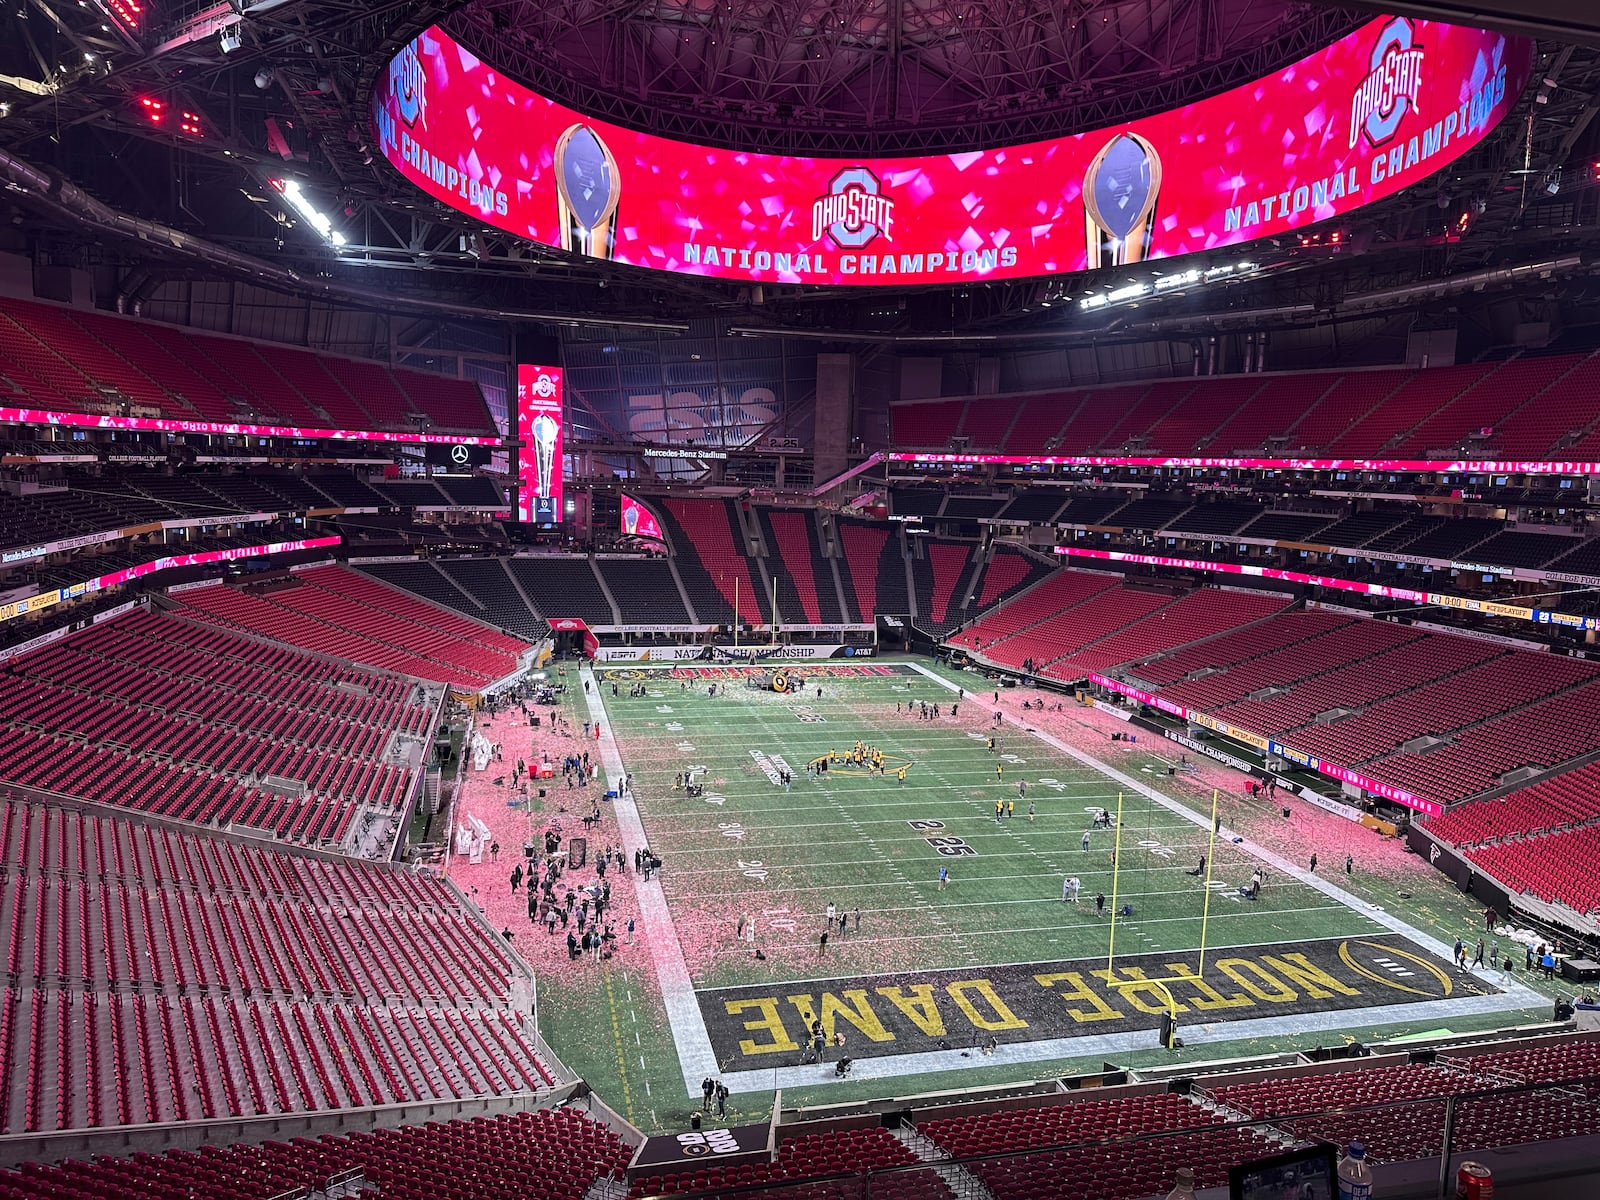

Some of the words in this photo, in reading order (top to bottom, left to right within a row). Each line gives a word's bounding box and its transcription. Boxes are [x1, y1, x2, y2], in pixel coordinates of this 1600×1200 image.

[1224, 173, 1360, 231] NATIONAL
[1370, 64, 1507, 185] CHAMPIONS
[402, 131, 509, 216] CHAMPIONS
[812, 194, 847, 241] OHIO
[847, 189, 894, 242] STATE
[684, 243, 827, 273] NATIONAL
[840, 247, 1018, 274] CHAMPIONS
[644, 449, 697, 459] Mercedes-Benz
[698, 451, 727, 460] Stadium
[1356, 550, 1378, 558] COLLEGE
[1379, 552, 1405, 561] FOOTBALL
[1406, 555, 1431, 564] PLAYOFF
[1451, 561, 1489, 573] Mercedes-Benz
[1490, 565, 1513, 575] Stadium
[1545, 572, 1579, 582] COLLEGE
[1445, 597, 1461, 607] 0:00
[1539, 612, 1550, 622] 23
[611, 651, 636, 659] ESPN
[674, 649, 729, 659] NATNAL
[1170, 732, 1178, 741] 25
[1178, 735, 1207, 756] NATIONAL
[1207, 748, 1251, 773] CHAMPIONSHIP
[1273, 744, 1283, 754] 23
[1275, 778, 1294, 791] ESPN
[1326, 765, 1370, 788] NATIONAL
[1374, 784, 1432, 812] CHAMPIONS
[1032, 951, 1362, 1023] NOTRE
[724, 978, 1030, 1055] DAME
[1352, 1187, 1369, 1196] DEJA
